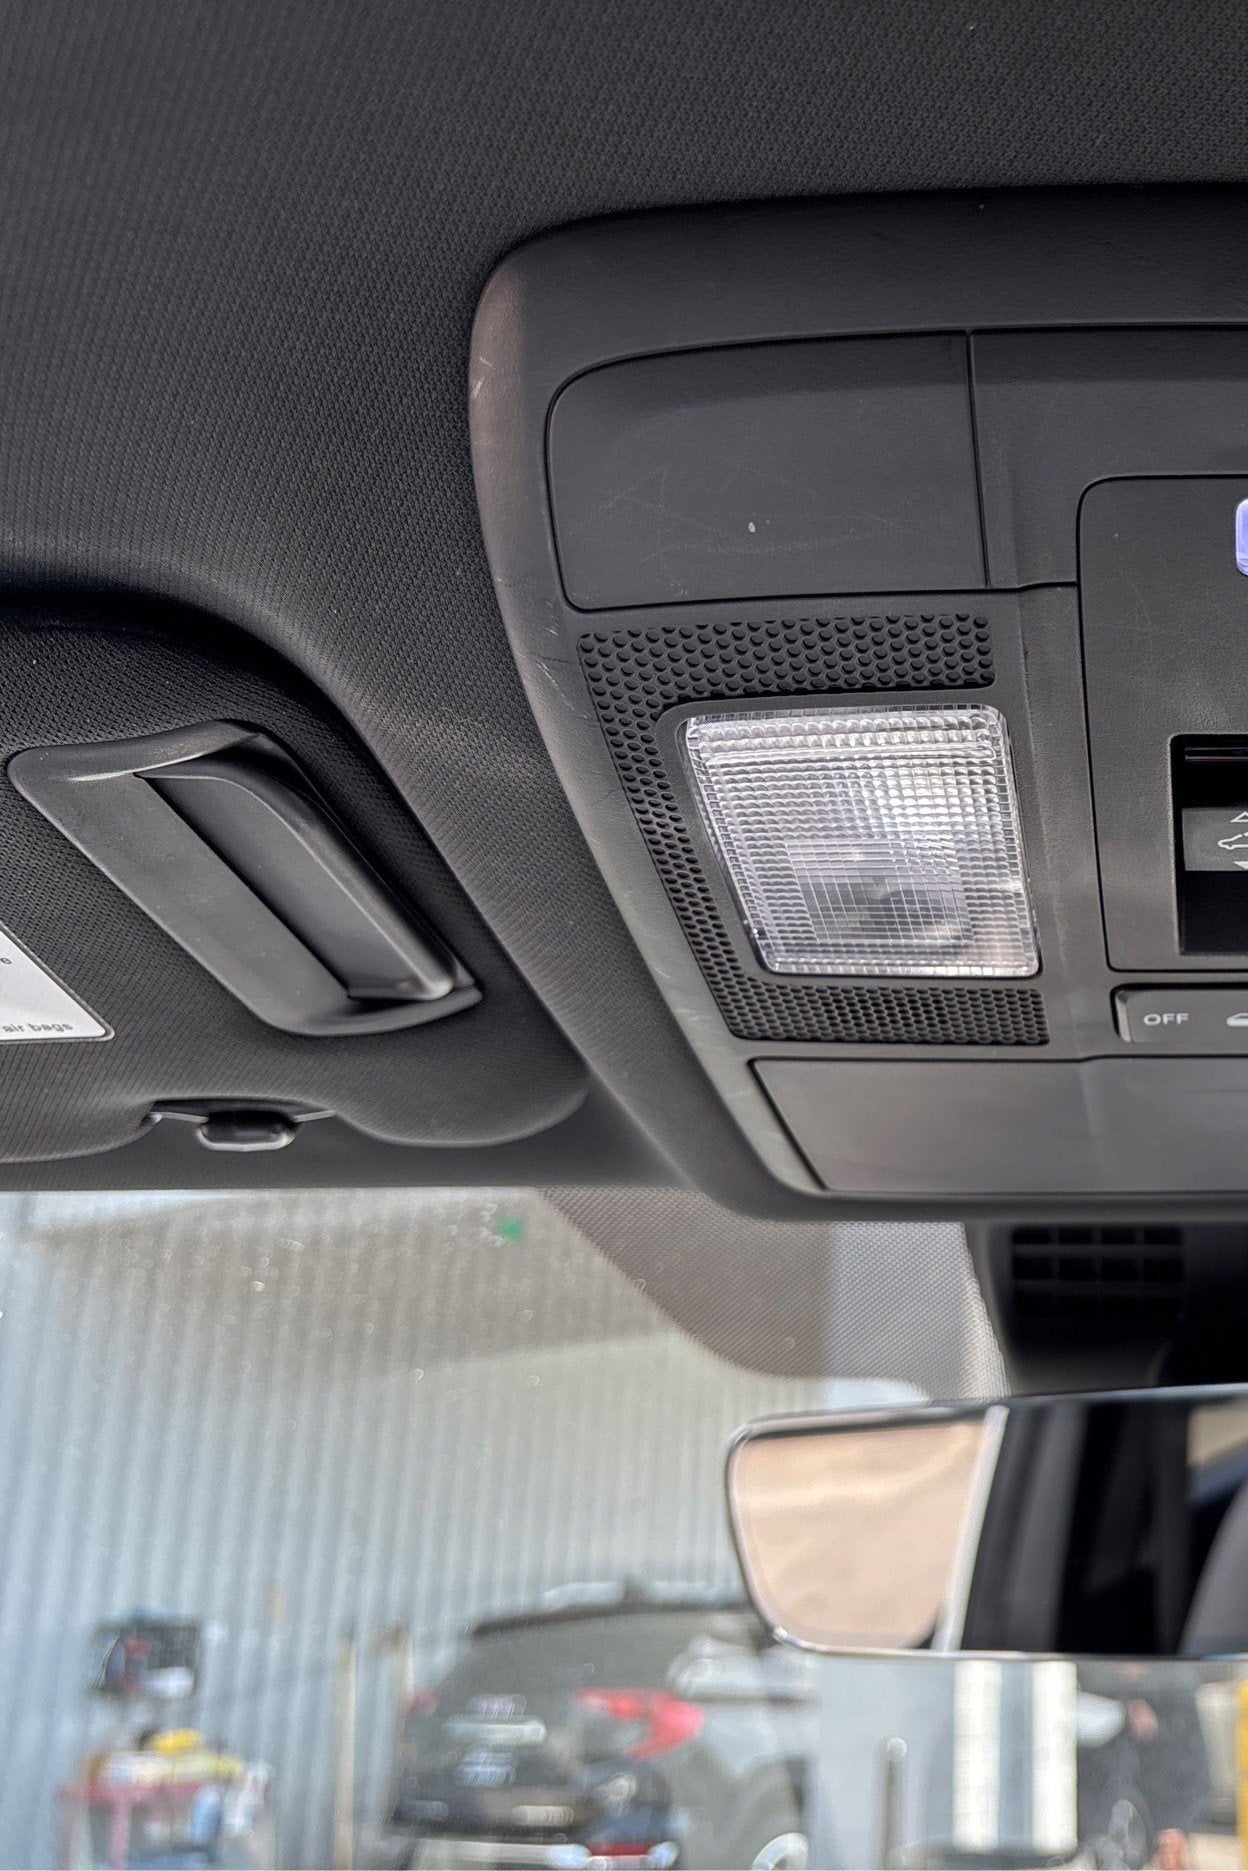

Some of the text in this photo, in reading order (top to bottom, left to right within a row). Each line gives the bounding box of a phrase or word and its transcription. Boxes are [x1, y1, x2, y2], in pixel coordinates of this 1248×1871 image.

[1143, 1012, 1189, 1026] OFF
[2, 1022, 74, 1033] air bags
